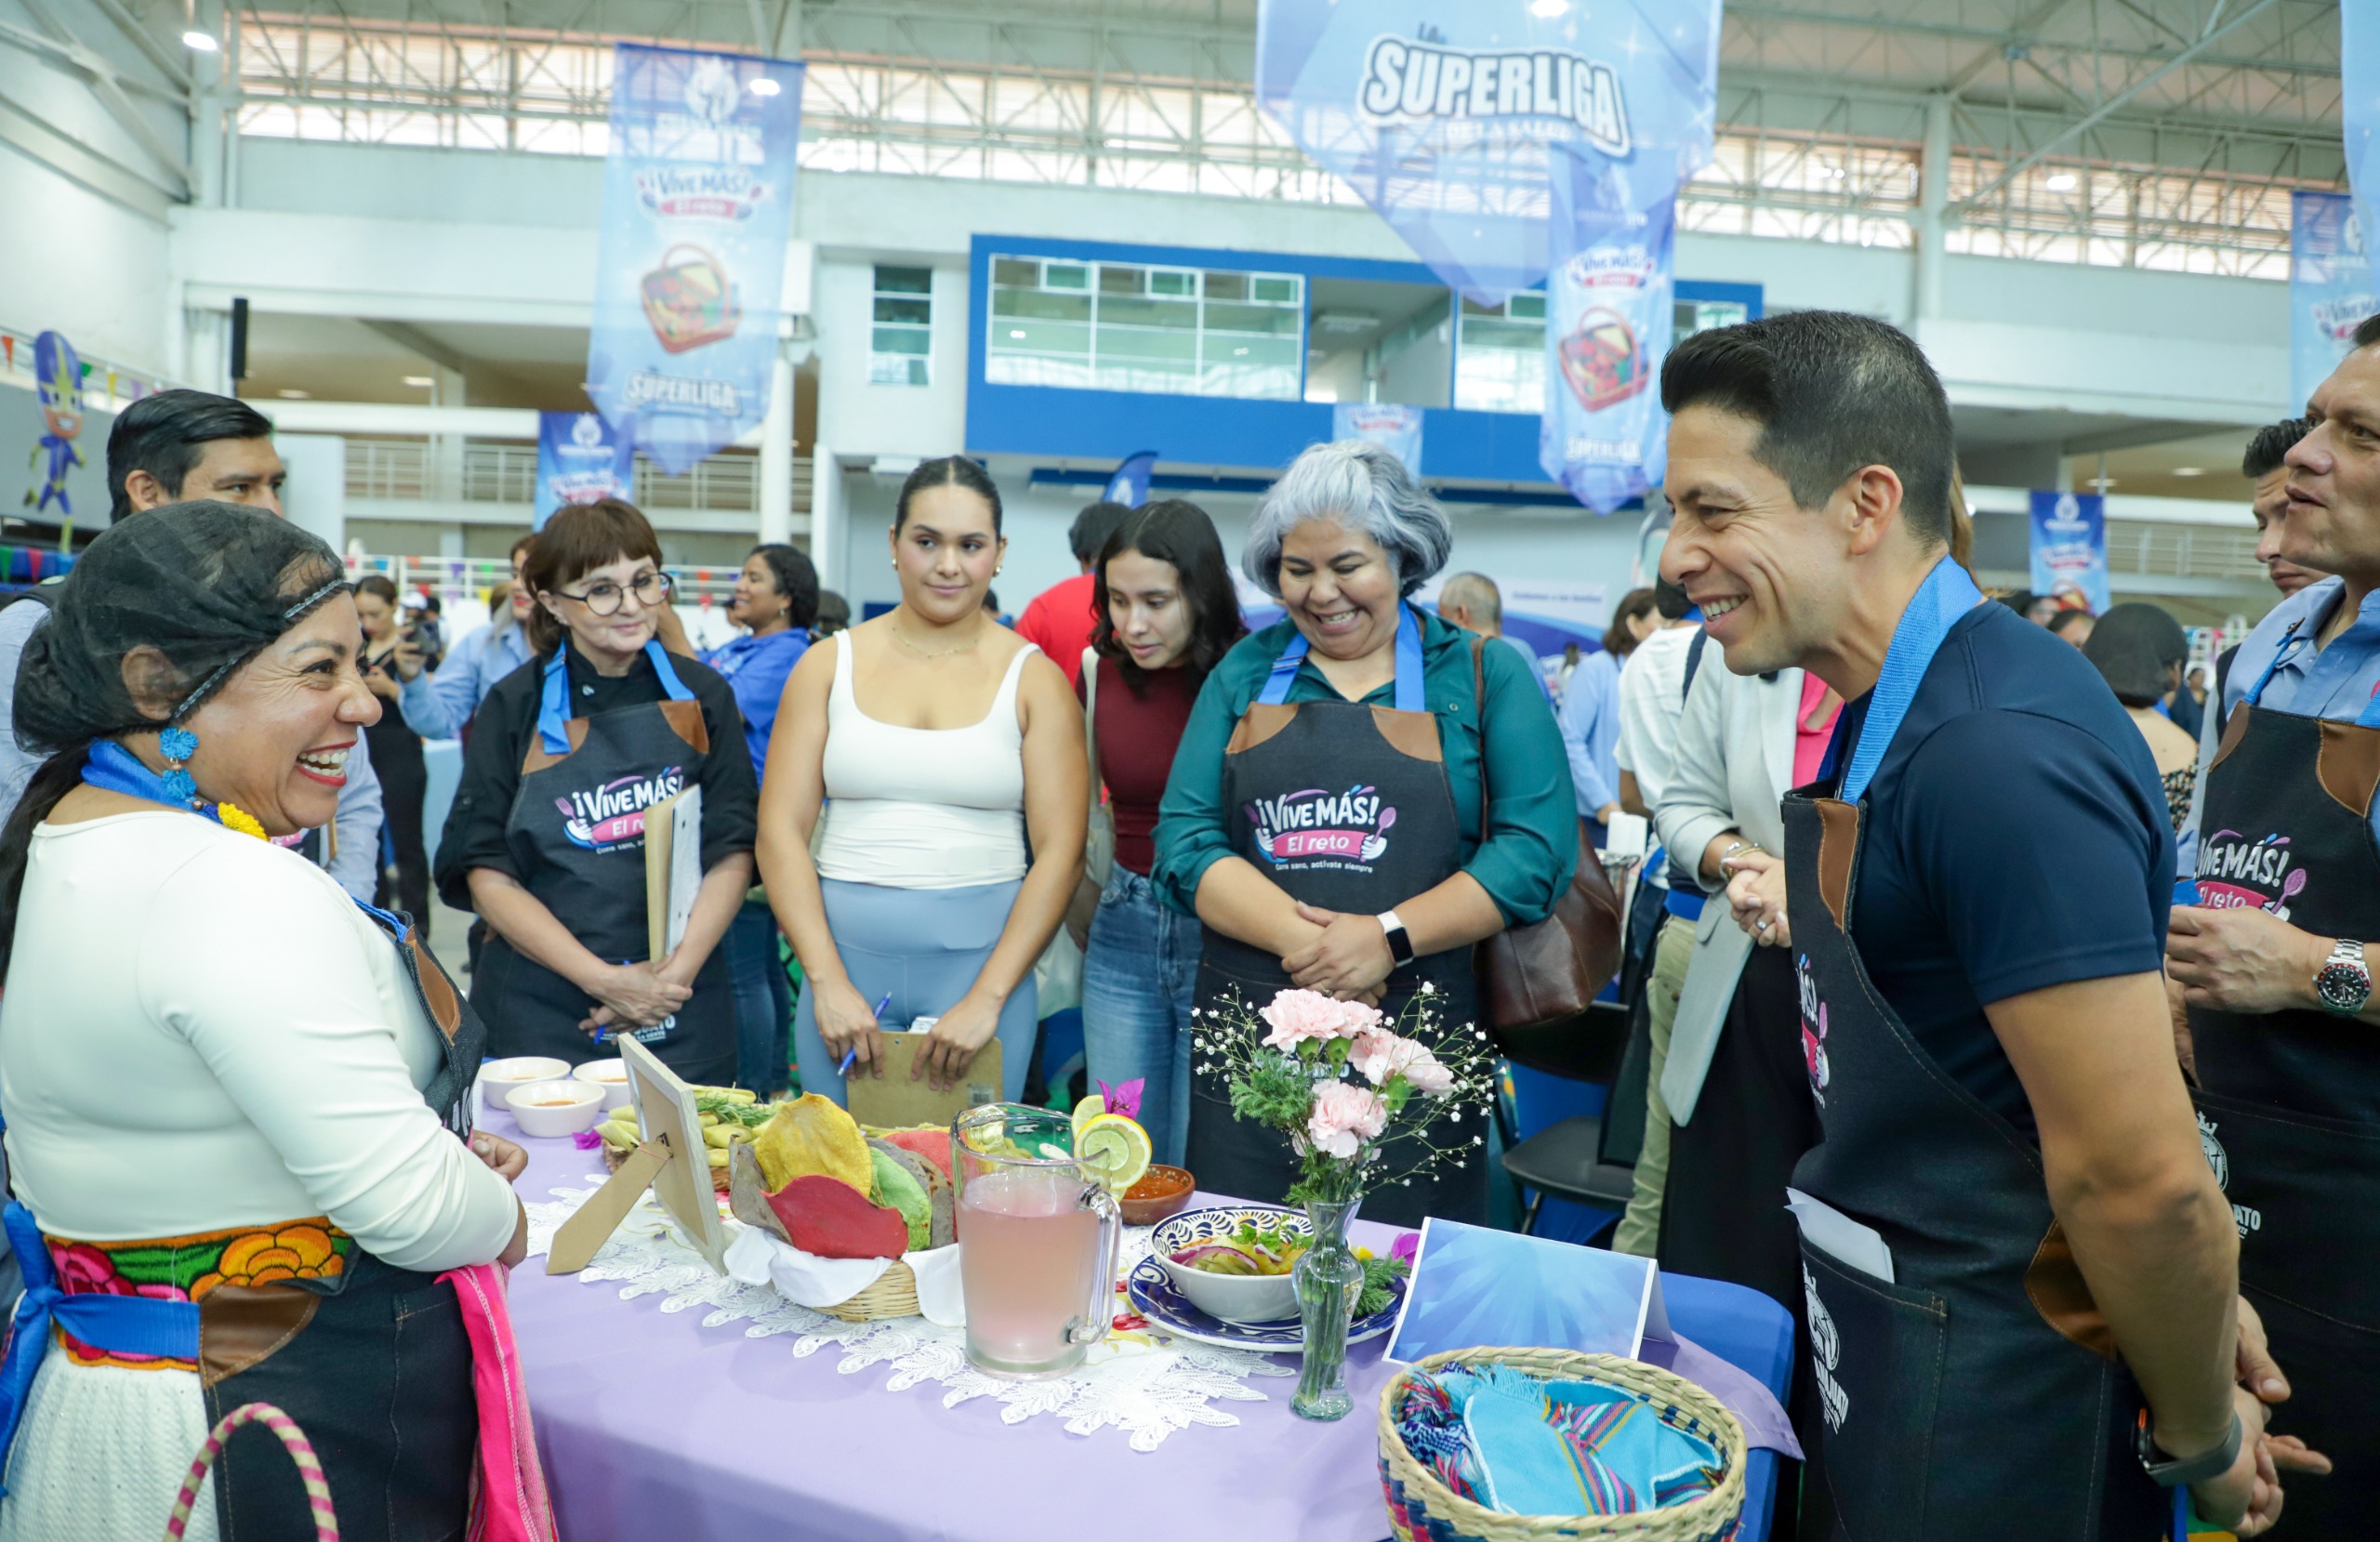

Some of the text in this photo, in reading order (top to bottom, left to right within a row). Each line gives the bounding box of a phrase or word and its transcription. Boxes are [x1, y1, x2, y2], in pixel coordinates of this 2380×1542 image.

[1361, 37, 1625, 147] SUPERLIGA
[626, 372, 740, 412] SUPERLIGA
[612, 818, 645, 837] El re
[1287, 834, 1350, 852] El reto
